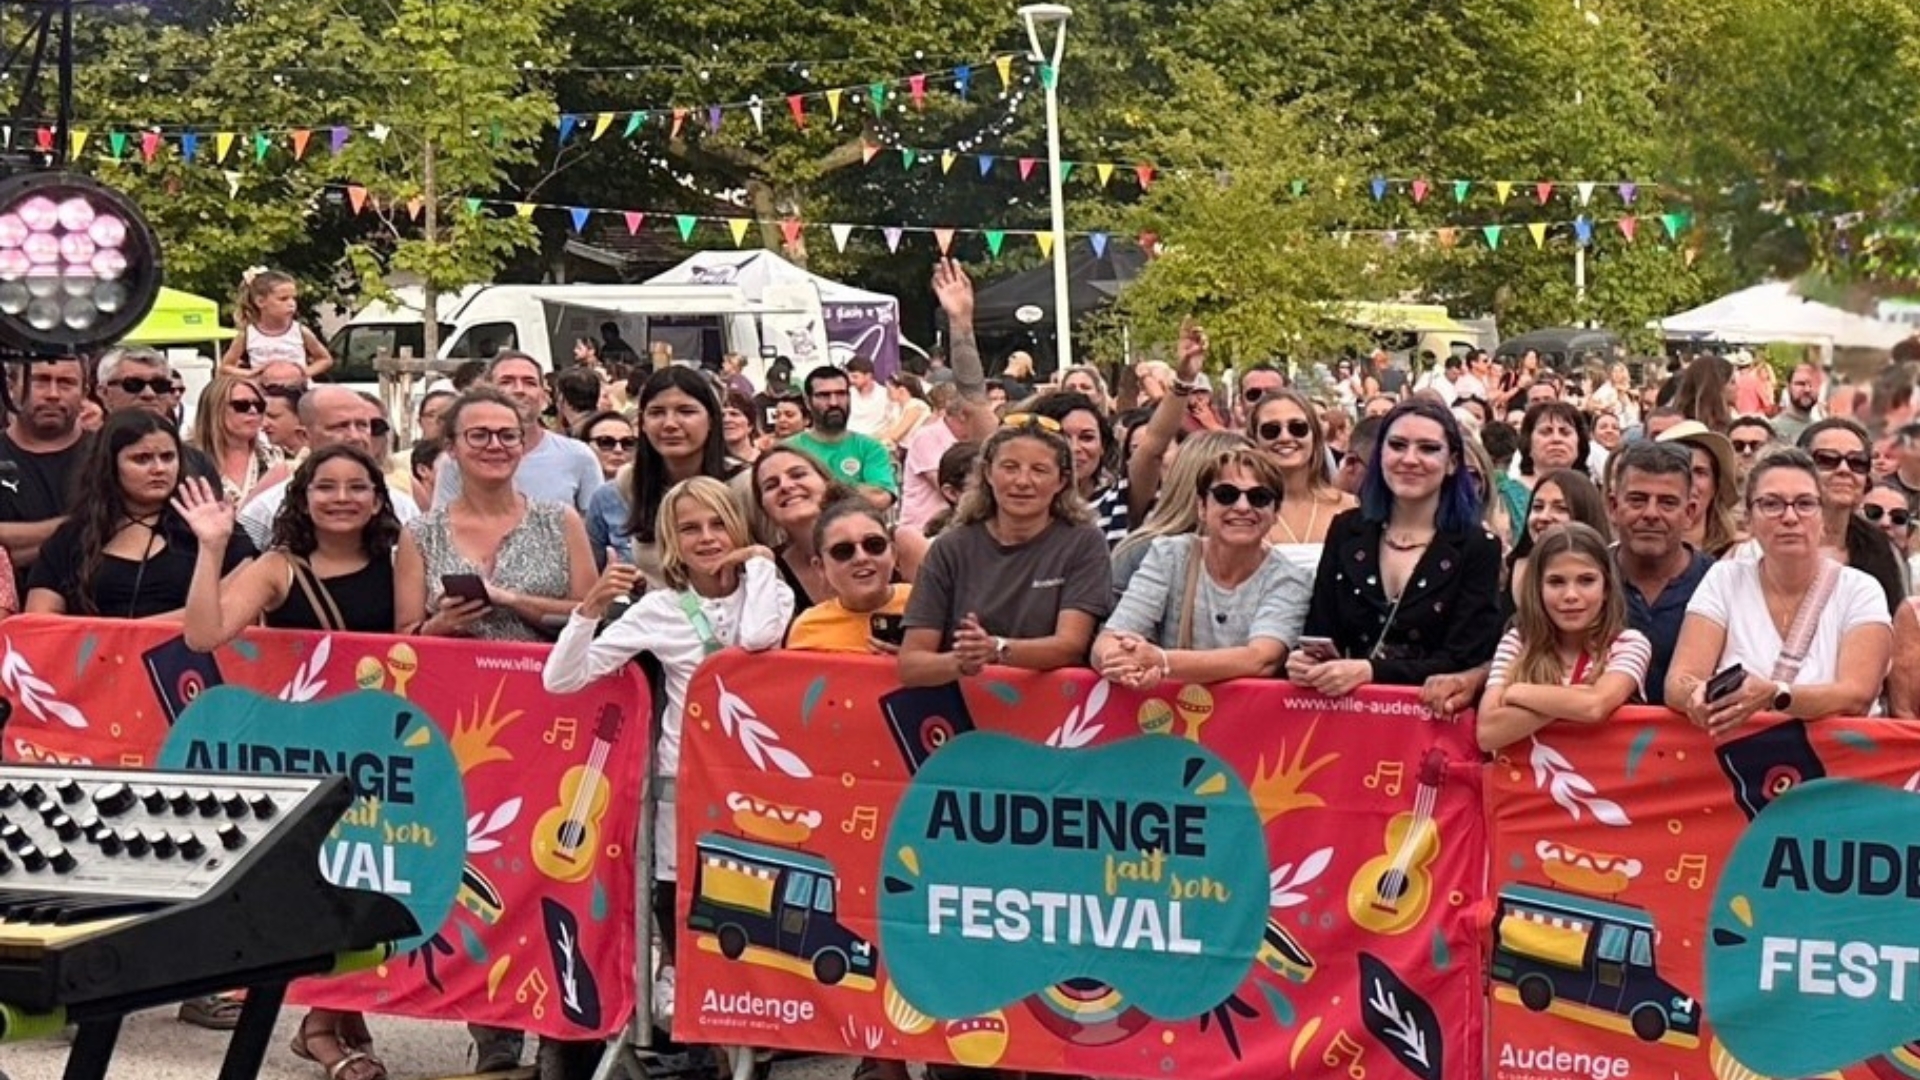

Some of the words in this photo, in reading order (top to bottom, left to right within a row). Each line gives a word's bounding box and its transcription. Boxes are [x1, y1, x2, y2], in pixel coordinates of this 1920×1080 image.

[926, 790, 1207, 857] AUDENGE
[1104, 844, 1168, 897] fait
[1169, 873, 1232, 902] son
[928, 884, 1202, 953] FESTIVAL
[1759, 936, 1920, 1001] FEST
[701, 989, 814, 1024] Audenge
[1499, 1043, 1630, 1080] Audenge
